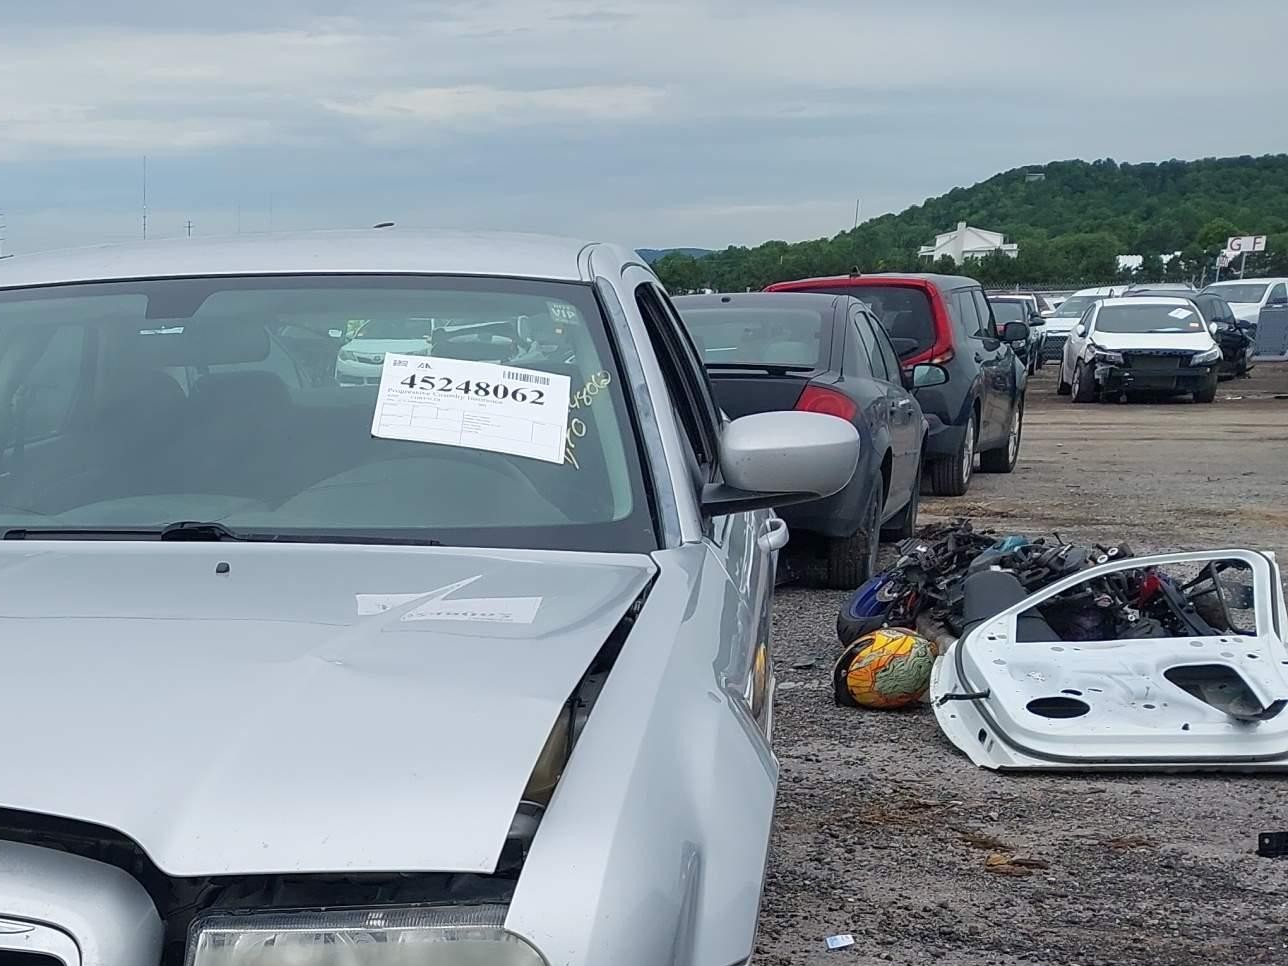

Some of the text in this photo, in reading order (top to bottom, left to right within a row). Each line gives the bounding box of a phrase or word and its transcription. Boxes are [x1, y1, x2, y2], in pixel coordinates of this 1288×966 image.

[1230, 236, 1263, 251] G F
[401, 373, 545, 406] 45248062
